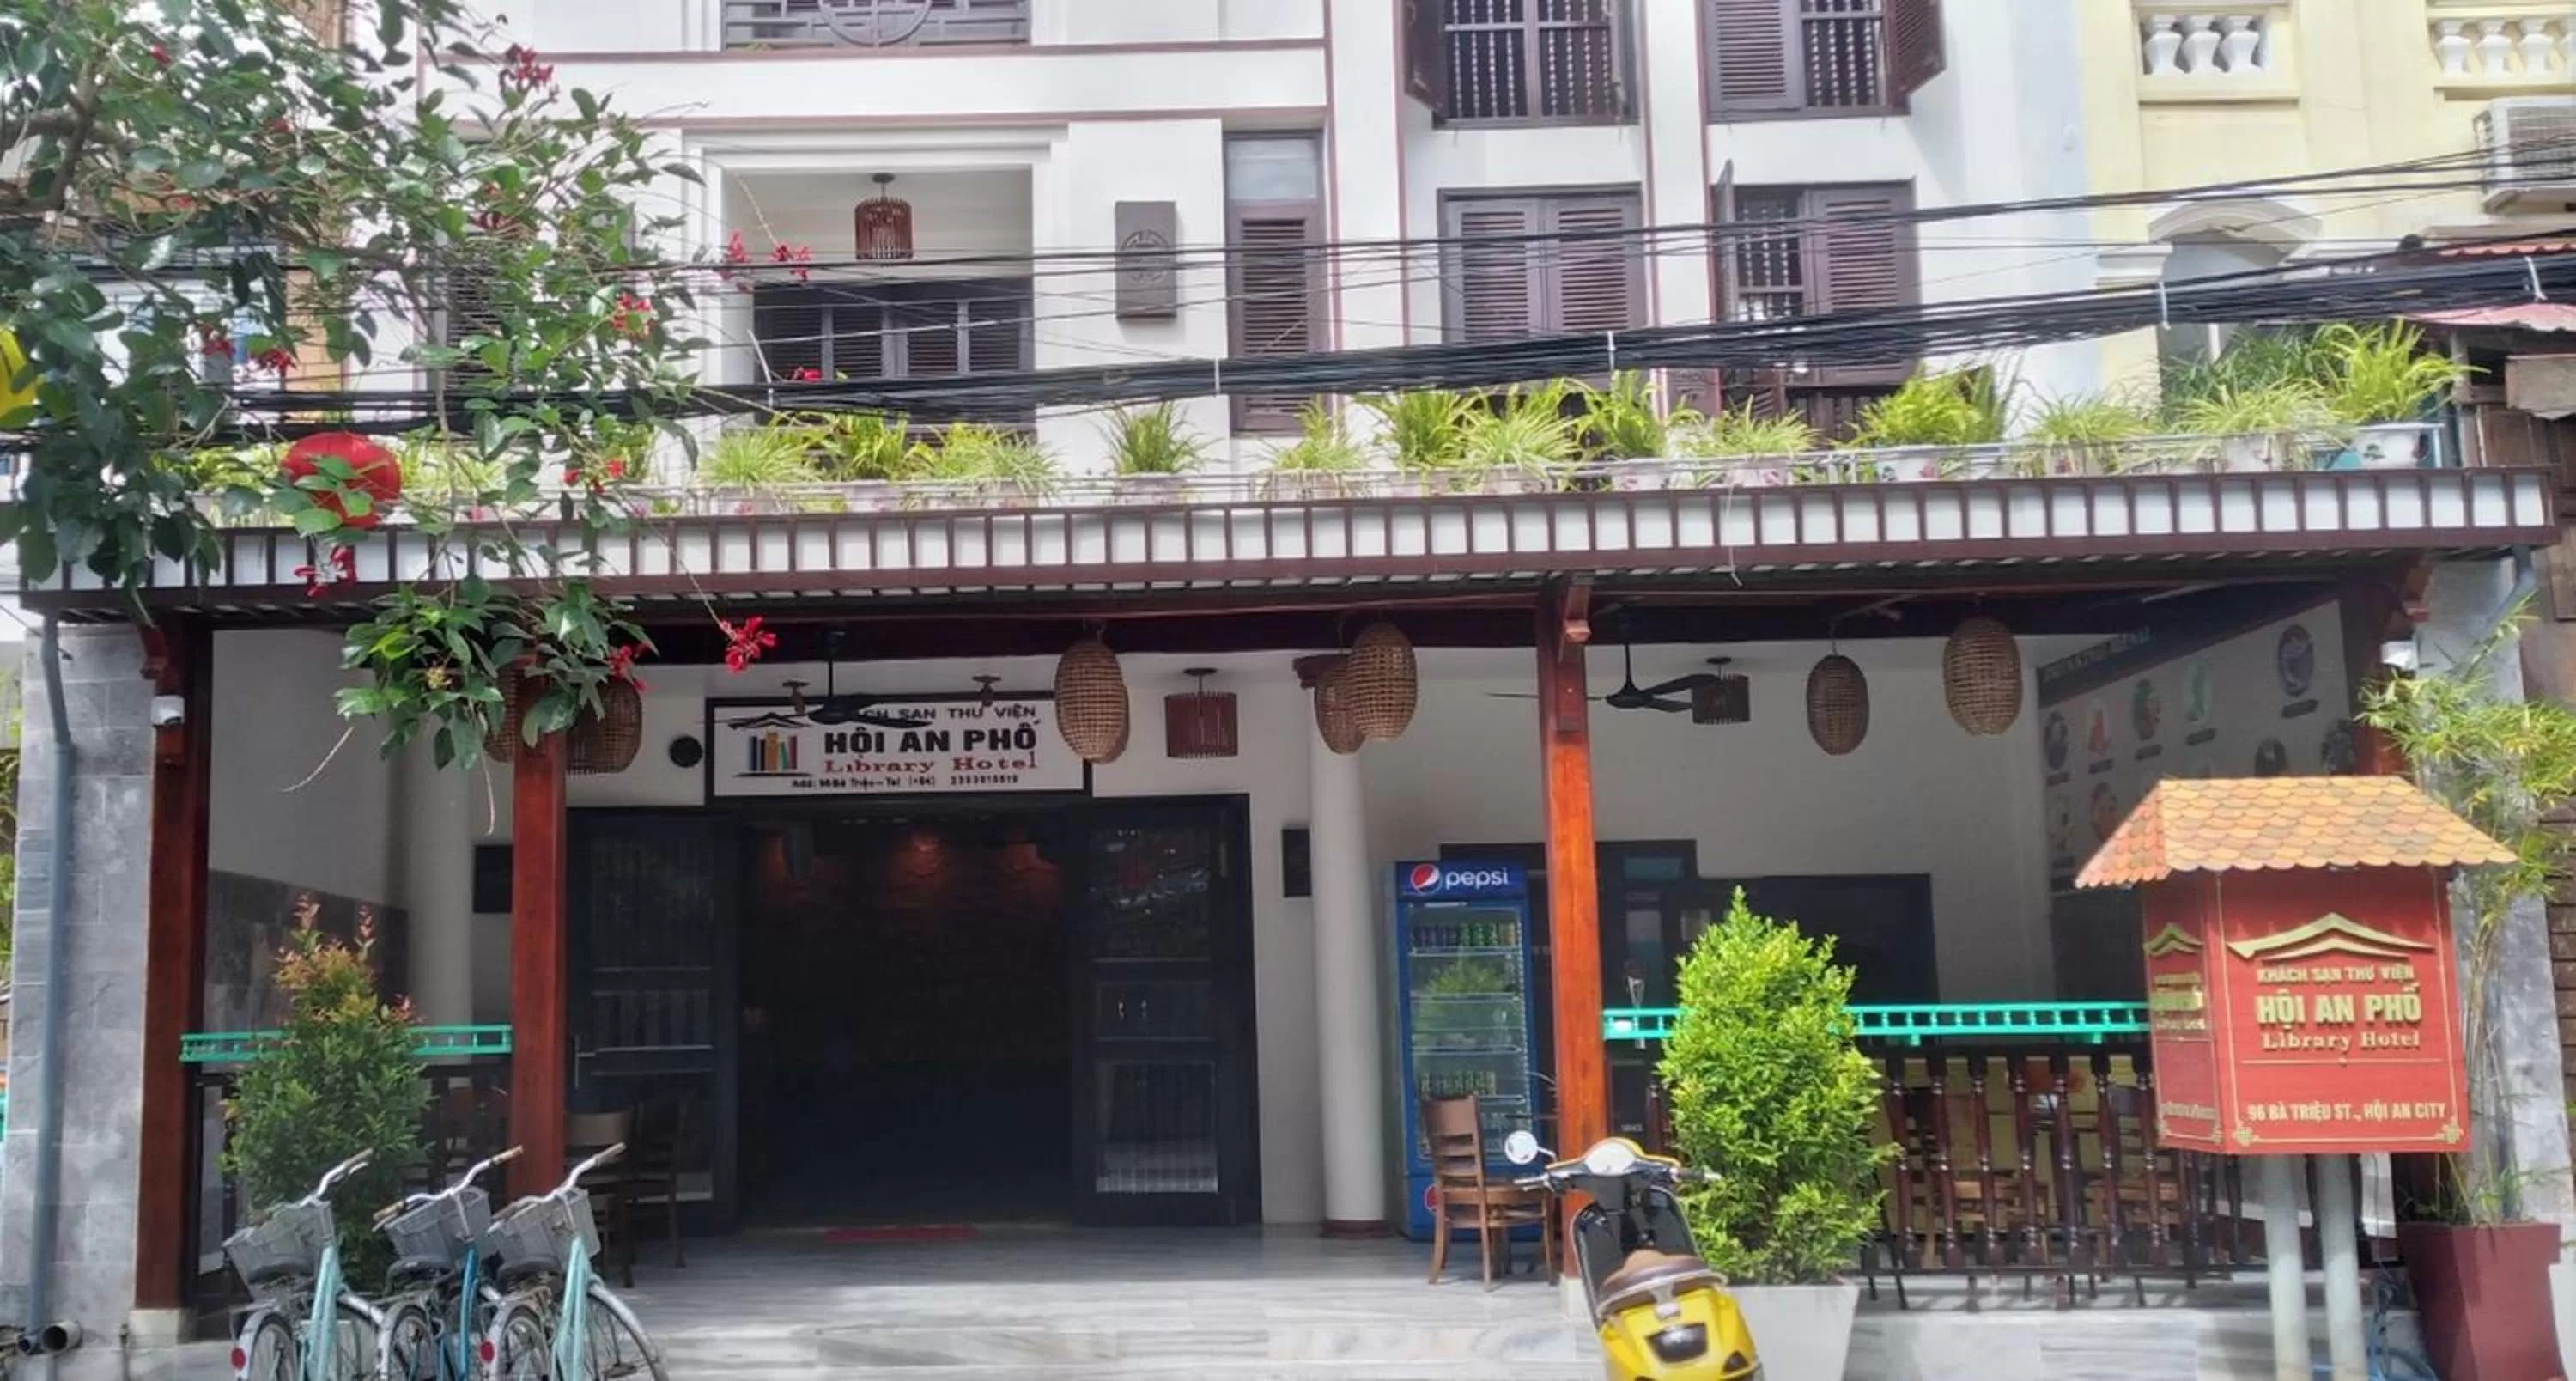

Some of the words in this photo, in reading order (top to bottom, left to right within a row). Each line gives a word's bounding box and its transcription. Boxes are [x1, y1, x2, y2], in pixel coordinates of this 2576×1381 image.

[994, 703, 1036, 720] VIỆN
[824, 727, 884, 757] HỘI
[899, 730, 950, 752] AN
[963, 719, 1041, 751] PHỐ
[824, 757, 935, 774] Library
[951, 751, 1038, 770] Hotel
[1445, 866, 1510, 890] pepsi
[2257, 965, 2308, 982] KHÁCH
[2311, 966, 2342, 983] SẠN
[2380, 964, 2415, 982] VIỆN
[2256, 989, 2306, 1030] HỘI
[2315, 994, 2355, 1023] AN
[2364, 983, 2422, 1023] PHỐ
[2262, 1031, 2352, 1051] Library
[2360, 1031, 2420, 1048] Hotel
[2247, 1104, 2265, 1121] 96
[2269, 1101, 2287, 1120] BÀ
[2289, 1100, 2332, 1122] TRIỆU
[2363, 1099, 2388, 1122] HỘI
[2392, 1104, 2411, 1120] AN
[2415, 1102, 2446, 1119] CITY
